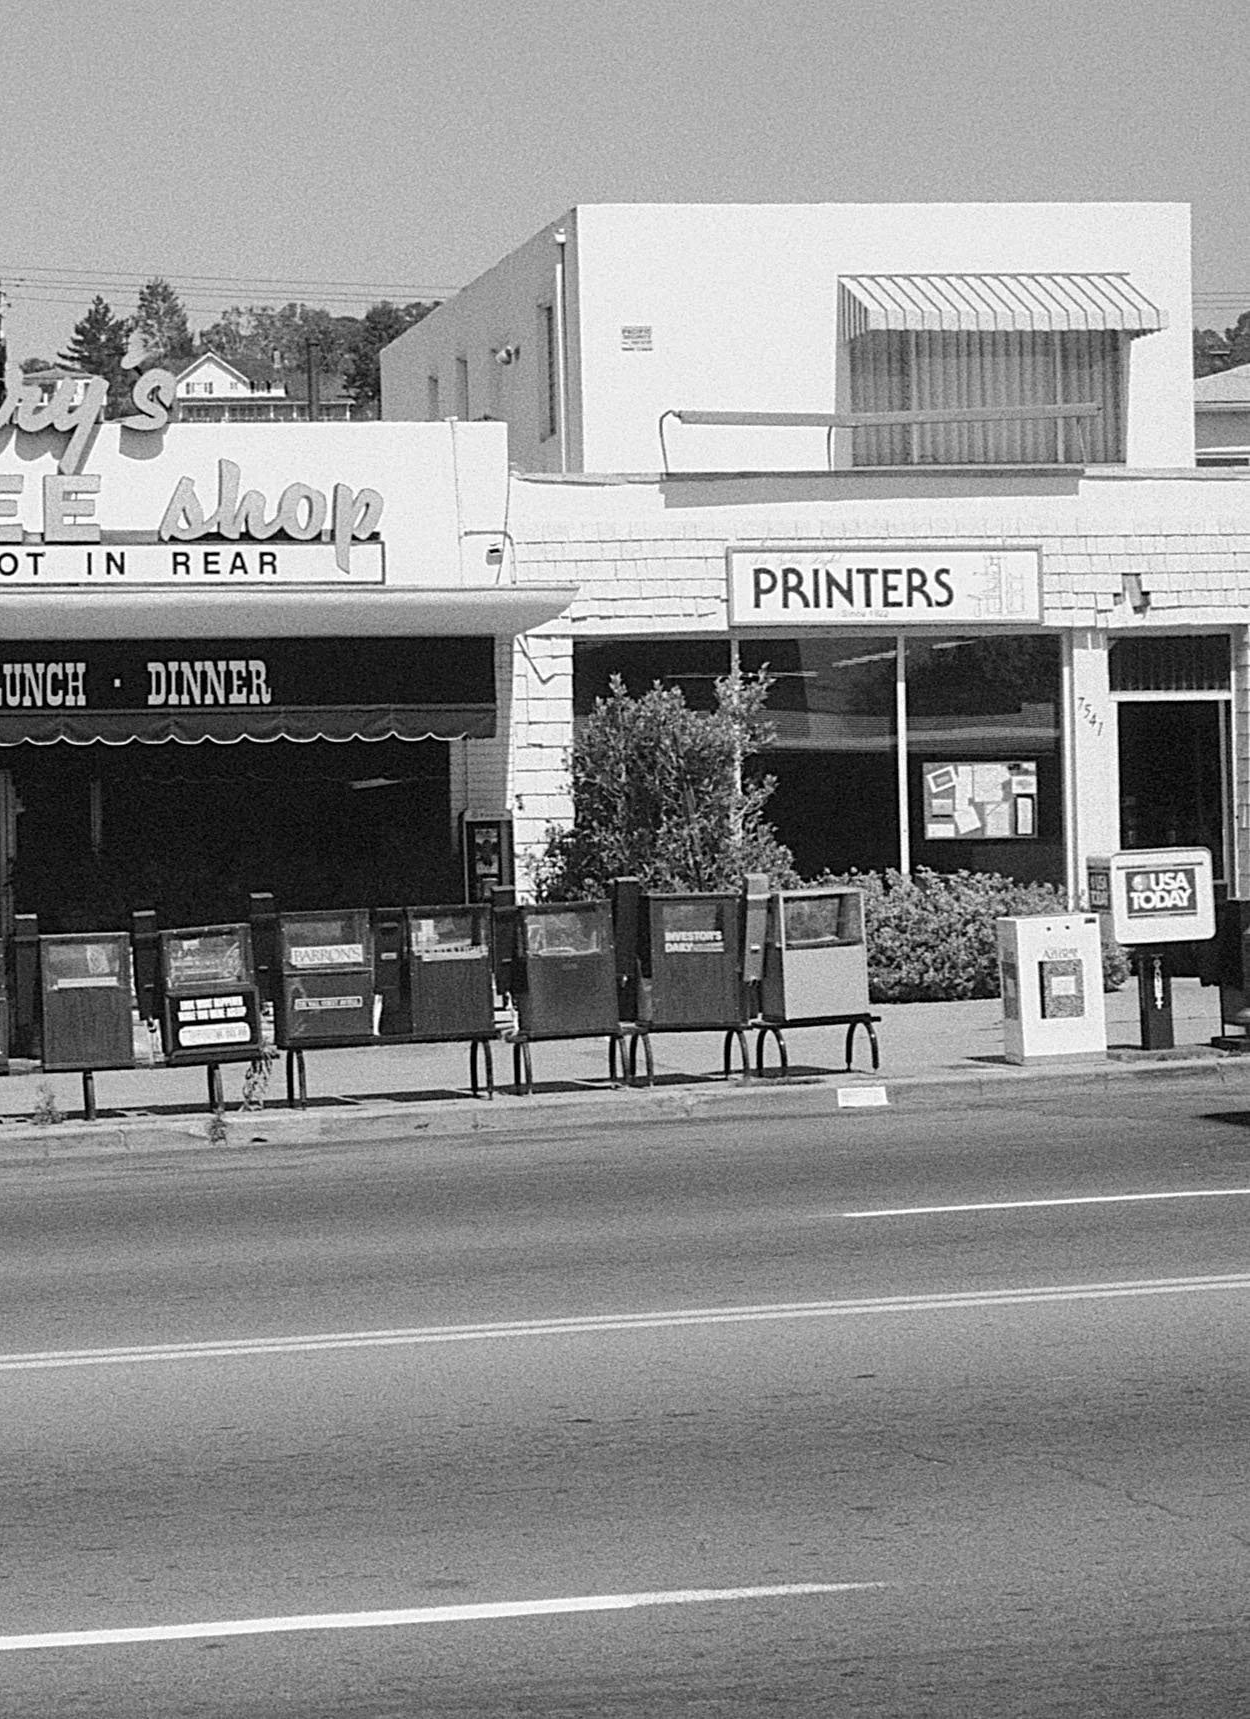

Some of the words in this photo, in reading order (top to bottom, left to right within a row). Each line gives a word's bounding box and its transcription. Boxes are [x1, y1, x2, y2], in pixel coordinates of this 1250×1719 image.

[159, 458, 384, 574] shop
[87, 551, 125, 575] IN
[172, 551, 278, 575] REAR
[753, 567, 954, 609] PRINTERS
[147, 660, 272, 705] DINNER
[1150, 871, 1191, 891] USA
[1130, 888, 1193, 910] TODAY
